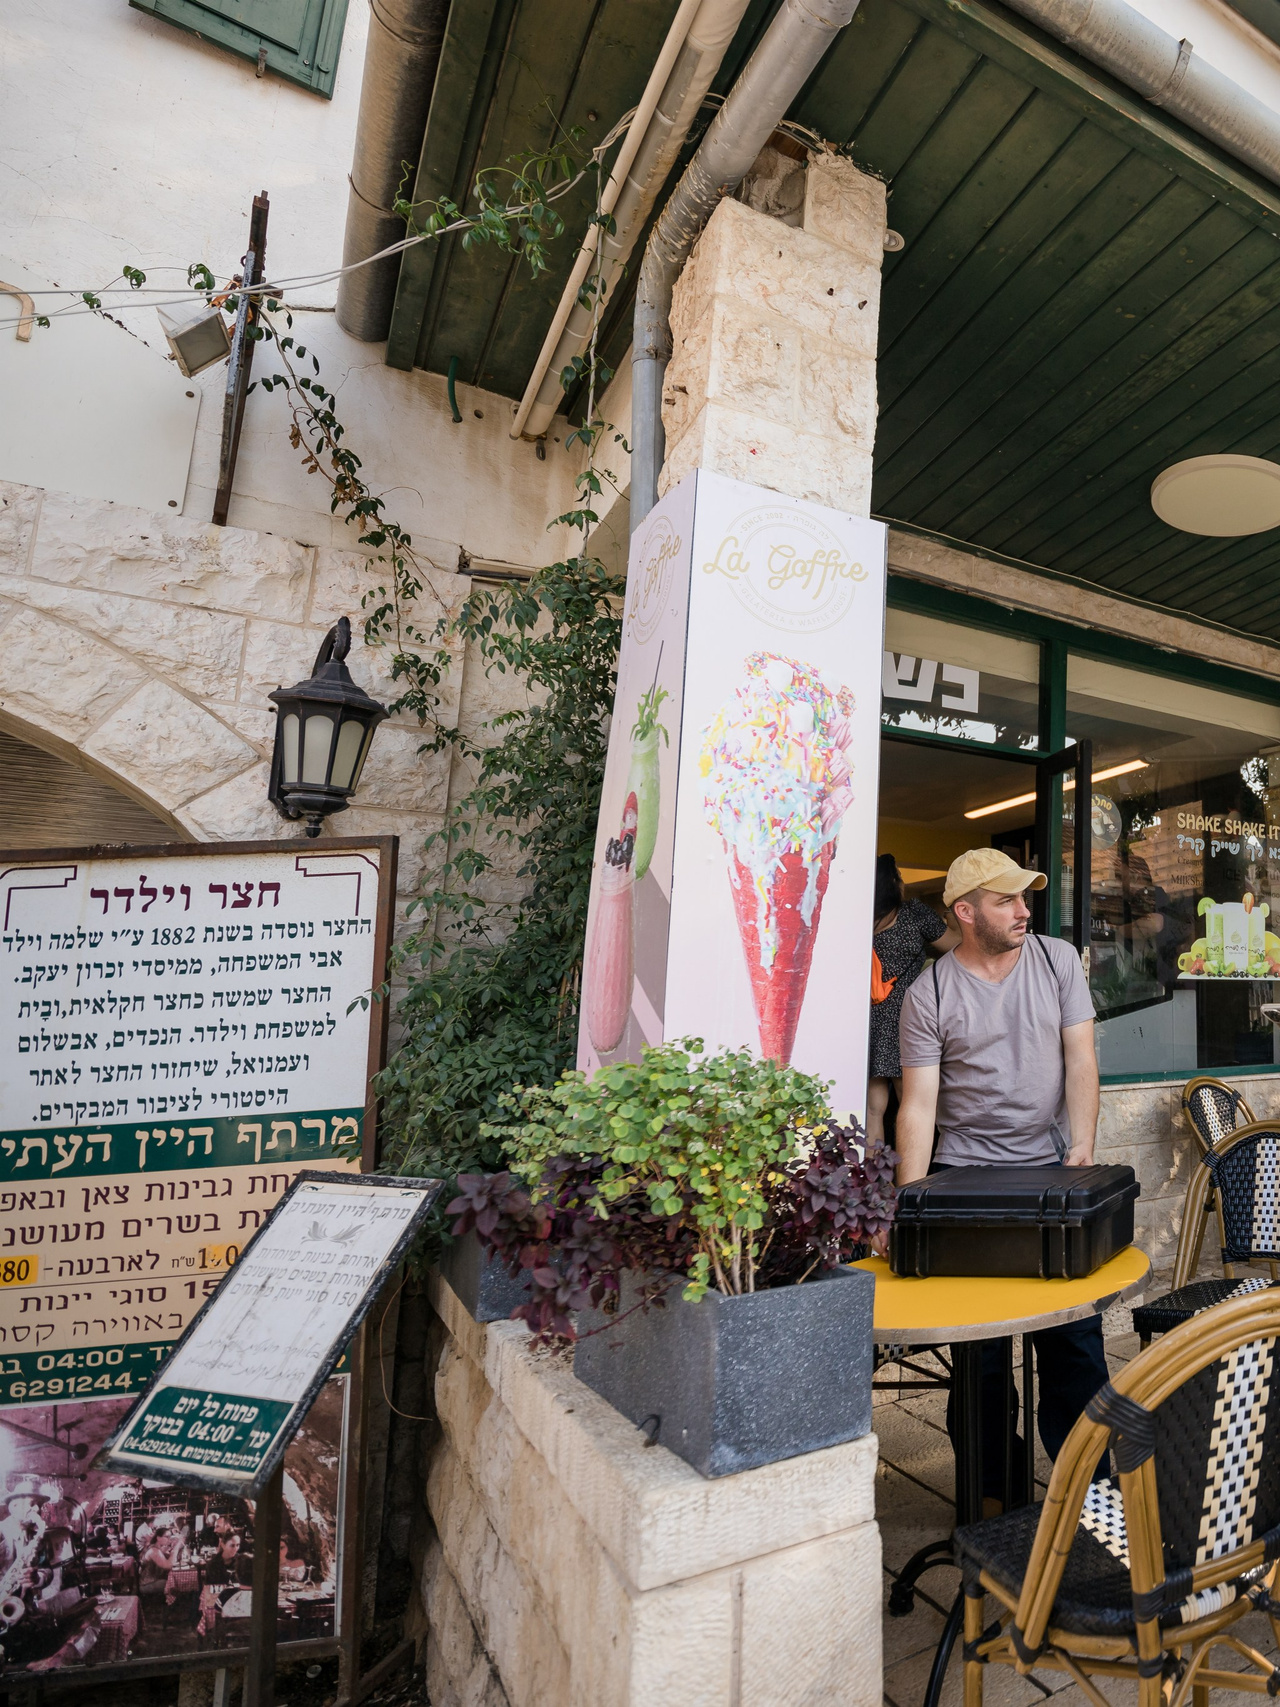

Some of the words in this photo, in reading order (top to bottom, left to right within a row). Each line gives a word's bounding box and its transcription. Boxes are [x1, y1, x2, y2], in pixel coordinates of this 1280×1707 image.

[741, 514, 764, 533] SINCE
[702, 535, 750, 581] La
[766, 544, 869, 600] Goffre
[740, 587, 786, 625] GELATERIA
[1176, 811, 1222, 834] SHAKE
[1224, 819, 1266, 839] SHAKE
[1176, 834, 1205, 857] קר?
[1210, 839, 1241, 858] שייק
[90, 875, 191, 915] וילדר
[209, 881, 281, 910] חצר
[49, 925, 104, 951] שלמה
[151, 926, 196, 946] 1882
[202, 925, 253, 944] בשנת
[261, 921, 315, 940] נוסדה
[322, 918, 372, 937] החצר
[132, 957, 203, 977] ממיסדי
[210, 952, 302, 977] המשפחה,
[309, 950, 343, 968] אבי
[14, 963, 68, 990] יעקב.
[76, 961, 124, 988] זכרון
[153, 991, 204, 1011] כחצר
[211, 988, 273, 1009] שמשה
[281, 985, 332, 1005] החצר
[189, 1017, 247, 1043] וילדר.
[253, 1012, 336, 1040] למשפחת
[18, 1027, 98, 1053] אבשלום
[105, 1026, 182, 1052] הנכדים,
[29, 1060, 82, 1087] לאתר
[91, 1062, 143, 1084] החצר
[151, 1056, 219, 1082] שיחזרו
[225, 1050, 310, 1080] ועמנואל,
[136, 1087, 202, 1114] לציבור
[211, 1086, 289, 1107] היסטורי
[32, 1097, 128, 1127] המבקרים.
[135, 1125, 214, 1169] היין
[237, 1115, 359, 1163] מרתף
[82, 1185, 130, 1213] צאן
[144, 1178, 232, 1202] גבינות
[284, 1201, 336, 1218] העתיק
[335, 1204, 367, 1220] היין
[366, 1205, 412, 1223] מרתף
[121, 1212, 221, 1238] בשרים
[300, 1250, 338, 1264] גבינות
[337, 1254, 379, 1268] ארוחת
[0, 1258, 30, 1283] 80
[327, 1272, 371, 1287] ארוחת
[19, 1292, 92, 1313] יינות
[109, 1286, 167, 1305] סוגי
[272, 1286, 303, 1301] יינות
[301, 1289, 330, 1302] סוגי
[330, 1291, 359, 1306] 150
[72, 1312, 183, 1337] באווירה
[37, 1348, 124, 1371] 04:00
[9, 1371, 133, 1398] 6291244
[172, 1396, 200, 1415] יום
[199, 1393, 221, 1419] כל
[217, 1402, 259, 1424] פתוח
[142, 1413, 185, 1438] בבוקר
[187, 1421, 236, 1444] 04:00
[123, 1436, 183, 1457] 04-6291244
[248, 1429, 271, 1449] עד
